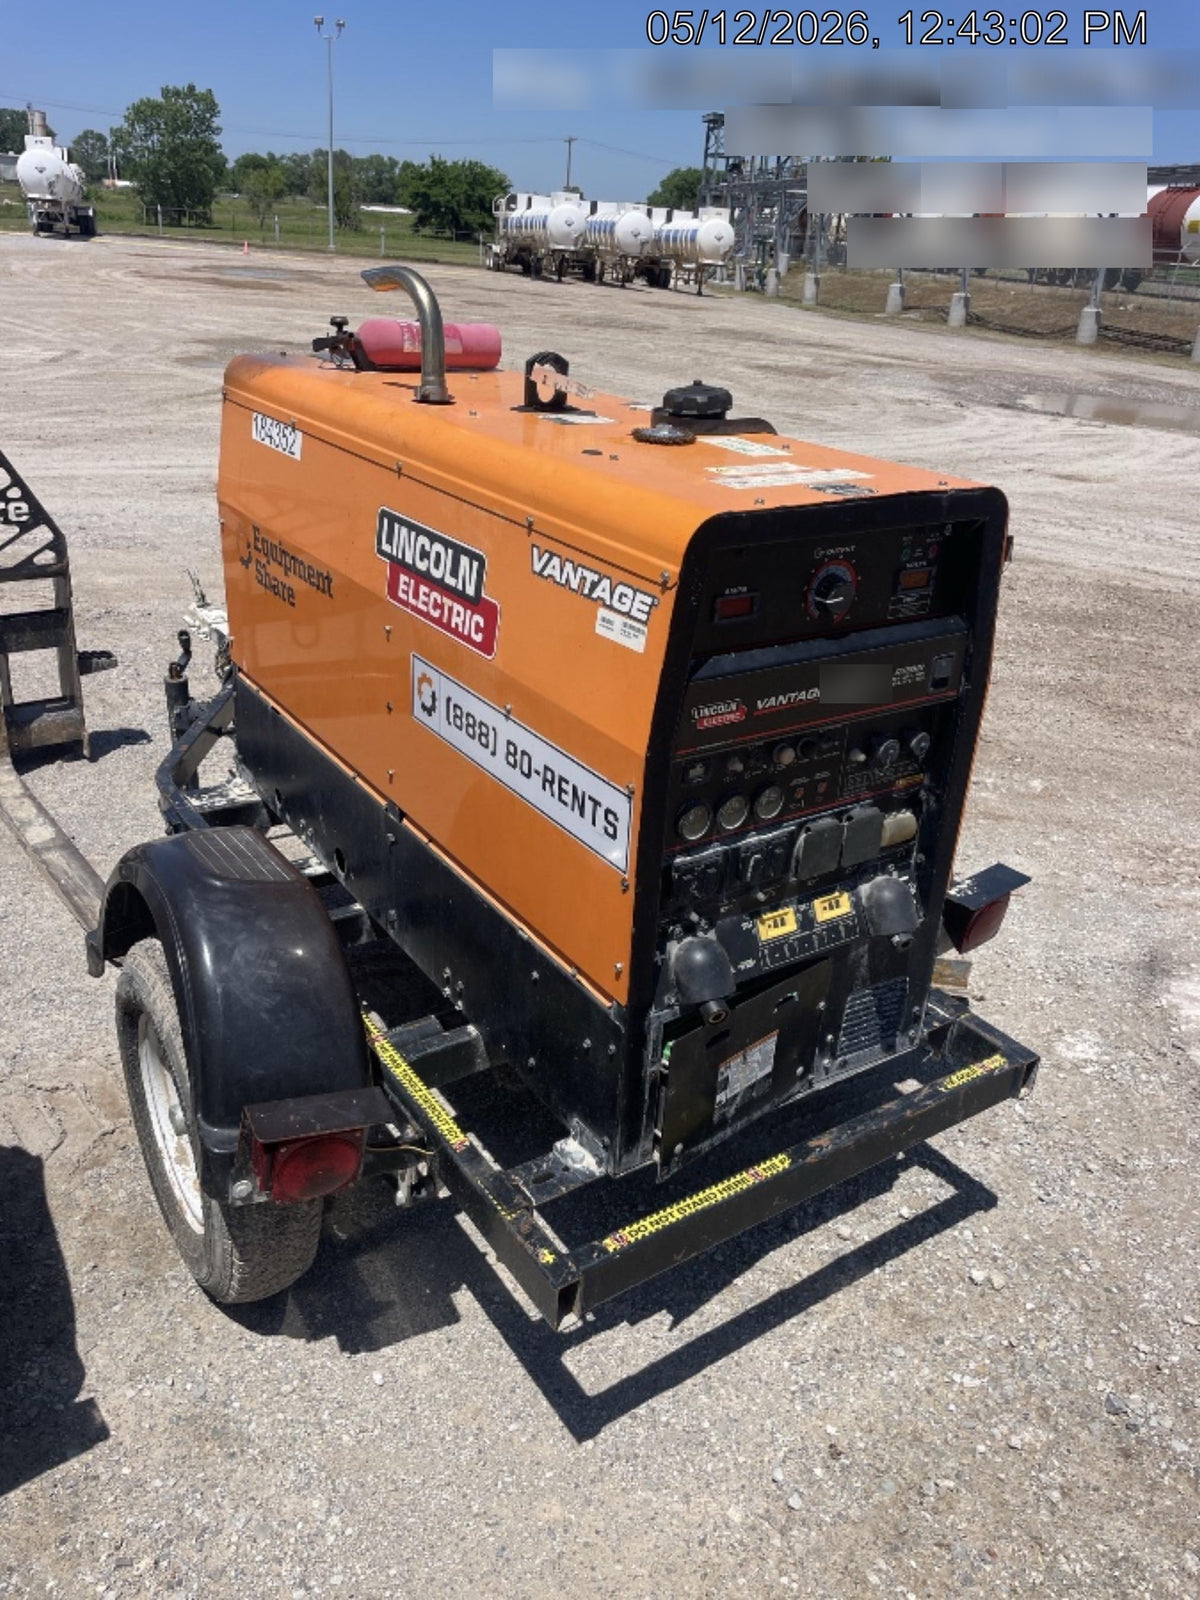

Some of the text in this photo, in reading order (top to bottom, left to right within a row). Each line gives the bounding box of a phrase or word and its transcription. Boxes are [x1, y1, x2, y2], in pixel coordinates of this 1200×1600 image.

[254, 414, 297, 456] 184352
[252, 525, 334, 599] Equipment
[255, 557, 297, 608] Share
[381, 517, 479, 598] LINCOLN
[397, 573, 485, 643] ELECTRIC
[693, 701, 739, 719] LINCOLN
[756, 687, 820, 710] VANTAG
[445, 695, 620, 842] (888) 80-RENTS
[628, 1223, 648, 1238] DO
[651, 1211, 675, 1229] NOT
[677, 1192, 718, 1214] STAND
[719, 1176, 750, 1196] HERE
